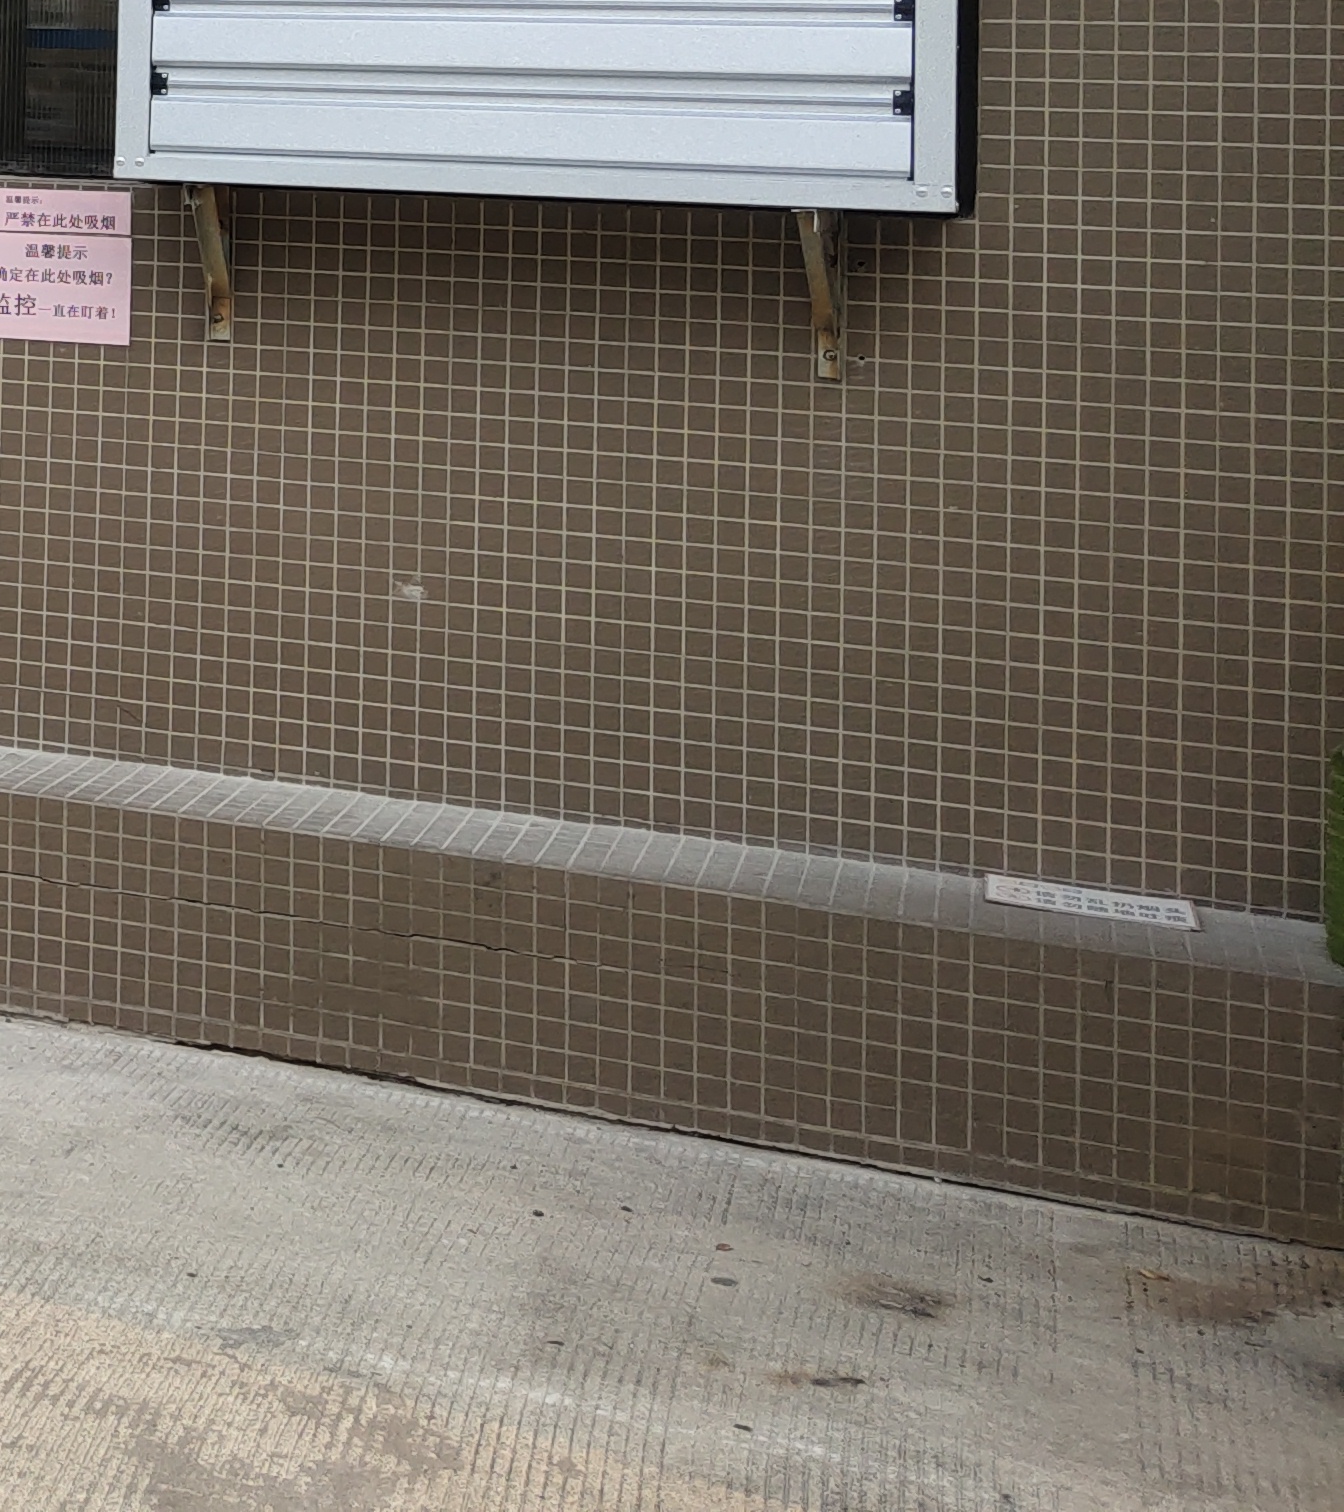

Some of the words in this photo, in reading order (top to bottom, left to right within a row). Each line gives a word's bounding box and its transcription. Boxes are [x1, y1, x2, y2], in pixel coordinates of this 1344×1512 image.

[4, 211, 116, 231] 严禁在此处吸烟
[25, 243, 89, 260] 温馨提示
